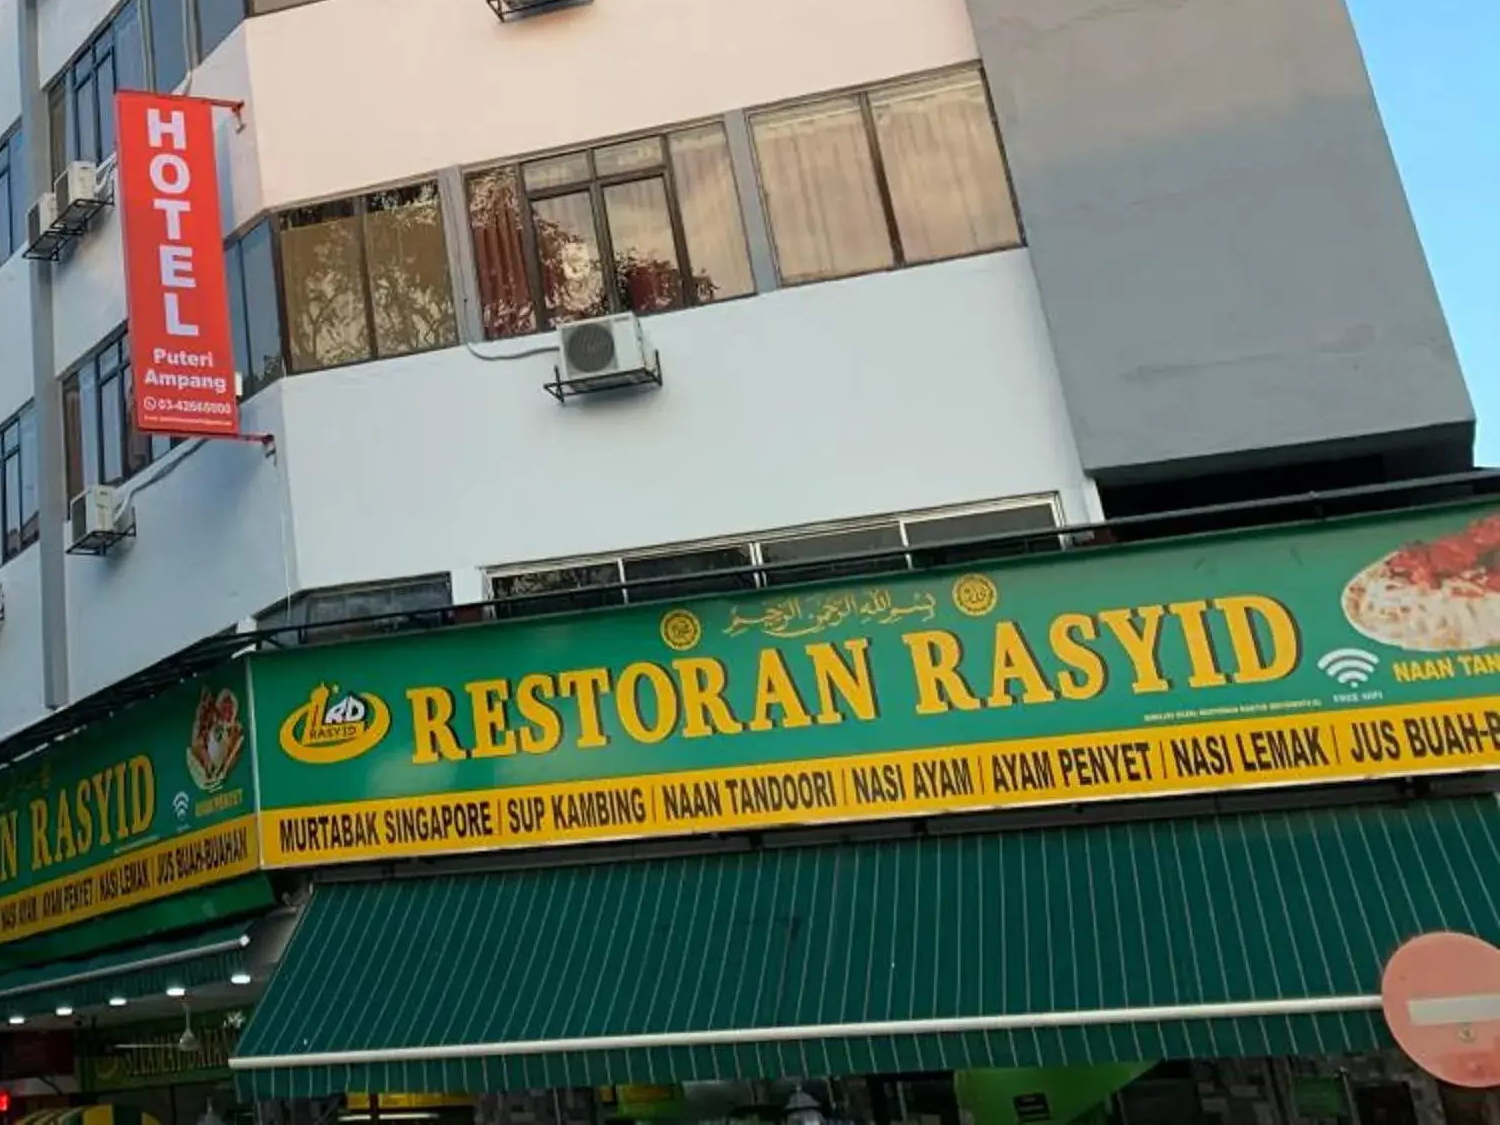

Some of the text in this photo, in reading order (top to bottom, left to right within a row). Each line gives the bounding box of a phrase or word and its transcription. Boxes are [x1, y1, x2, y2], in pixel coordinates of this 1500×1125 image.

[147, 107, 199, 337] HOTEL
[144, 368, 227, 394] Ampang
[153, 347, 214, 368] Puteri
[406, 595, 1299, 765] RESTORAN RASYID
[1392, 657, 1456, 683] NAAN
[309, 726, 358, 740] RASYID
[30, 755, 156, 871] RASYID
[279, 811, 381, 854] MURTABAK
[384, 801, 493, 845] SINGAPORE
[507, 795, 546, 834] SUP
[552, 786, 646, 830] KAMBING
[662, 779, 722, 820] NAAN
[725, 771, 837, 816] TANDOORI
[852, 764, 906, 804] NASI
[913, 756, 974, 799] AYAM
[992, 750, 1056, 793] AYAM
[1058, 741, 1153, 787] PENYET
[1171, 734, 1234, 777] NASI
[1235, 726, 1330, 773] LEMAK
[1351, 719, 1402, 763] JUS
